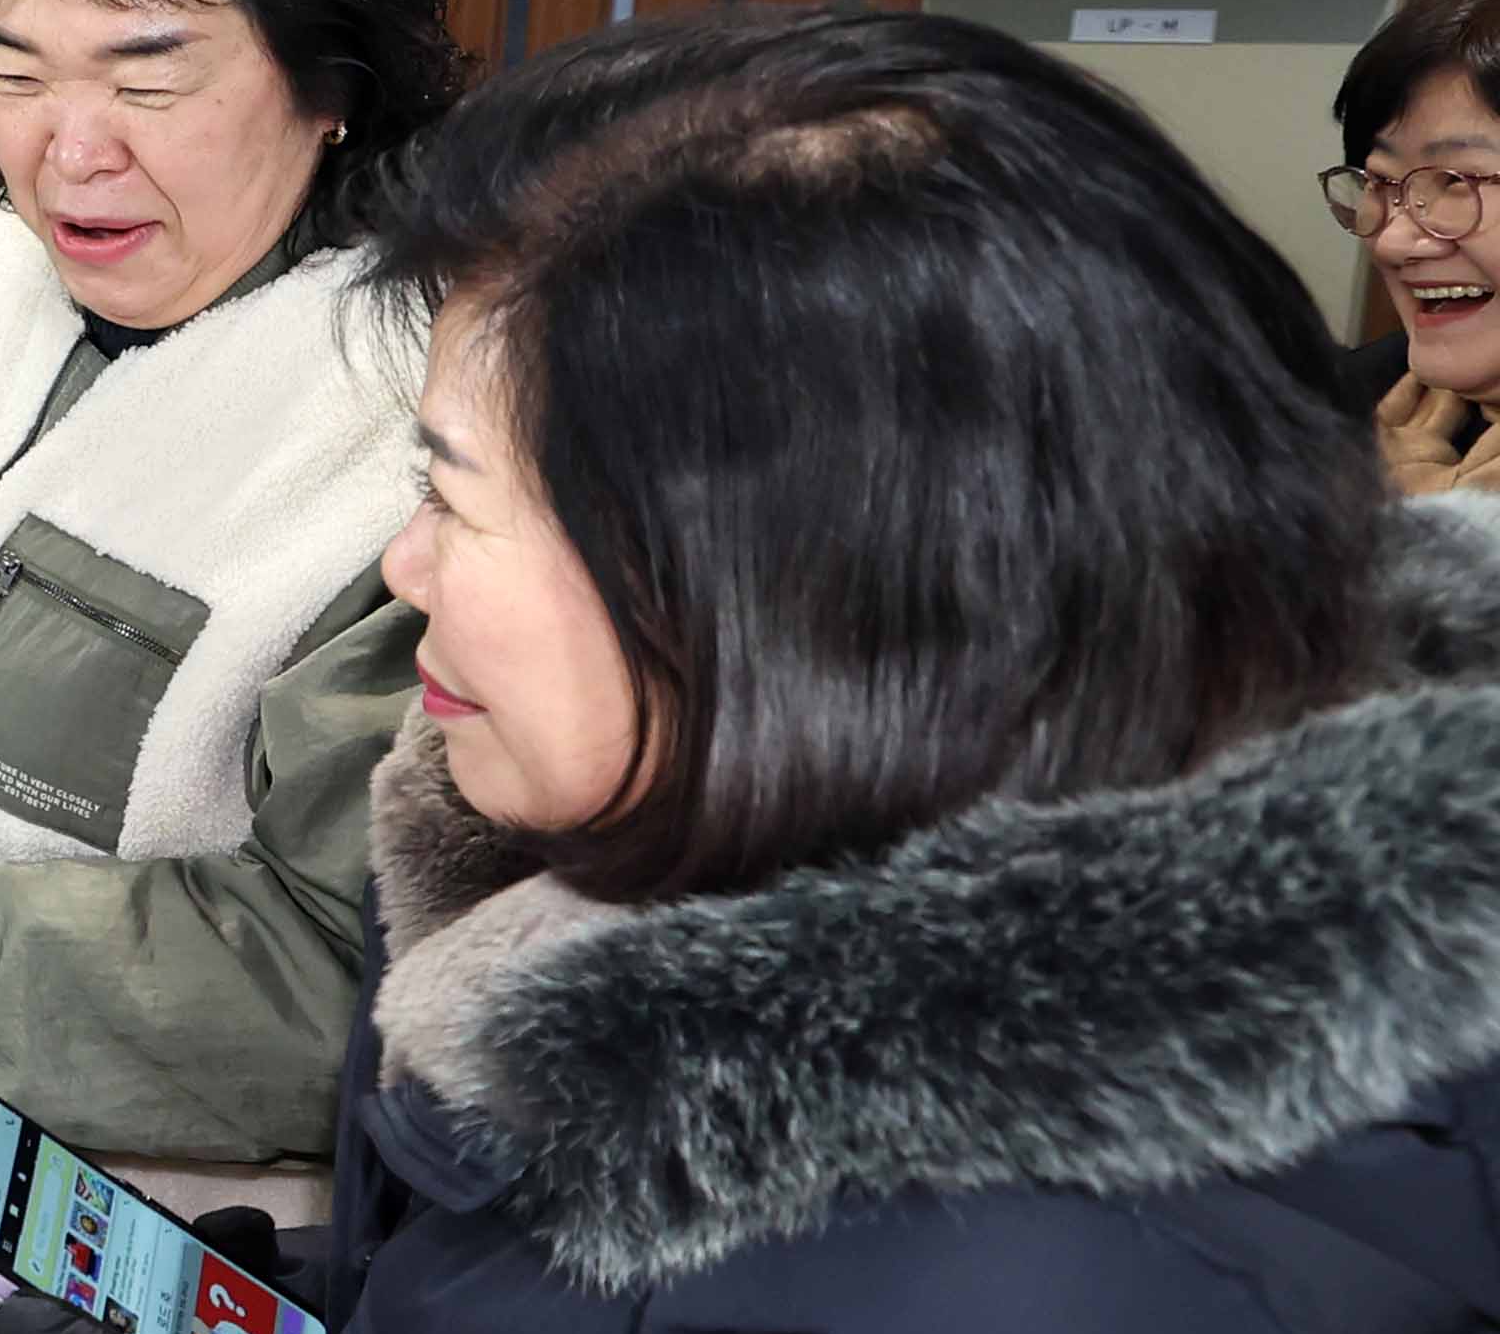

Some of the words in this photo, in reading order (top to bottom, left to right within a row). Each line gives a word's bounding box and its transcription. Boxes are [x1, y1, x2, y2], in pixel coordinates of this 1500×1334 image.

[15, 779, 39, 798] WITH
[39, 792, 61, 807] OUR
[62, 801, 91, 819] LIVES
[18, 770, 29, 783] IS
[29, 775, 55, 793] VERY
[55, 788, 101, 812] CLOSELY
